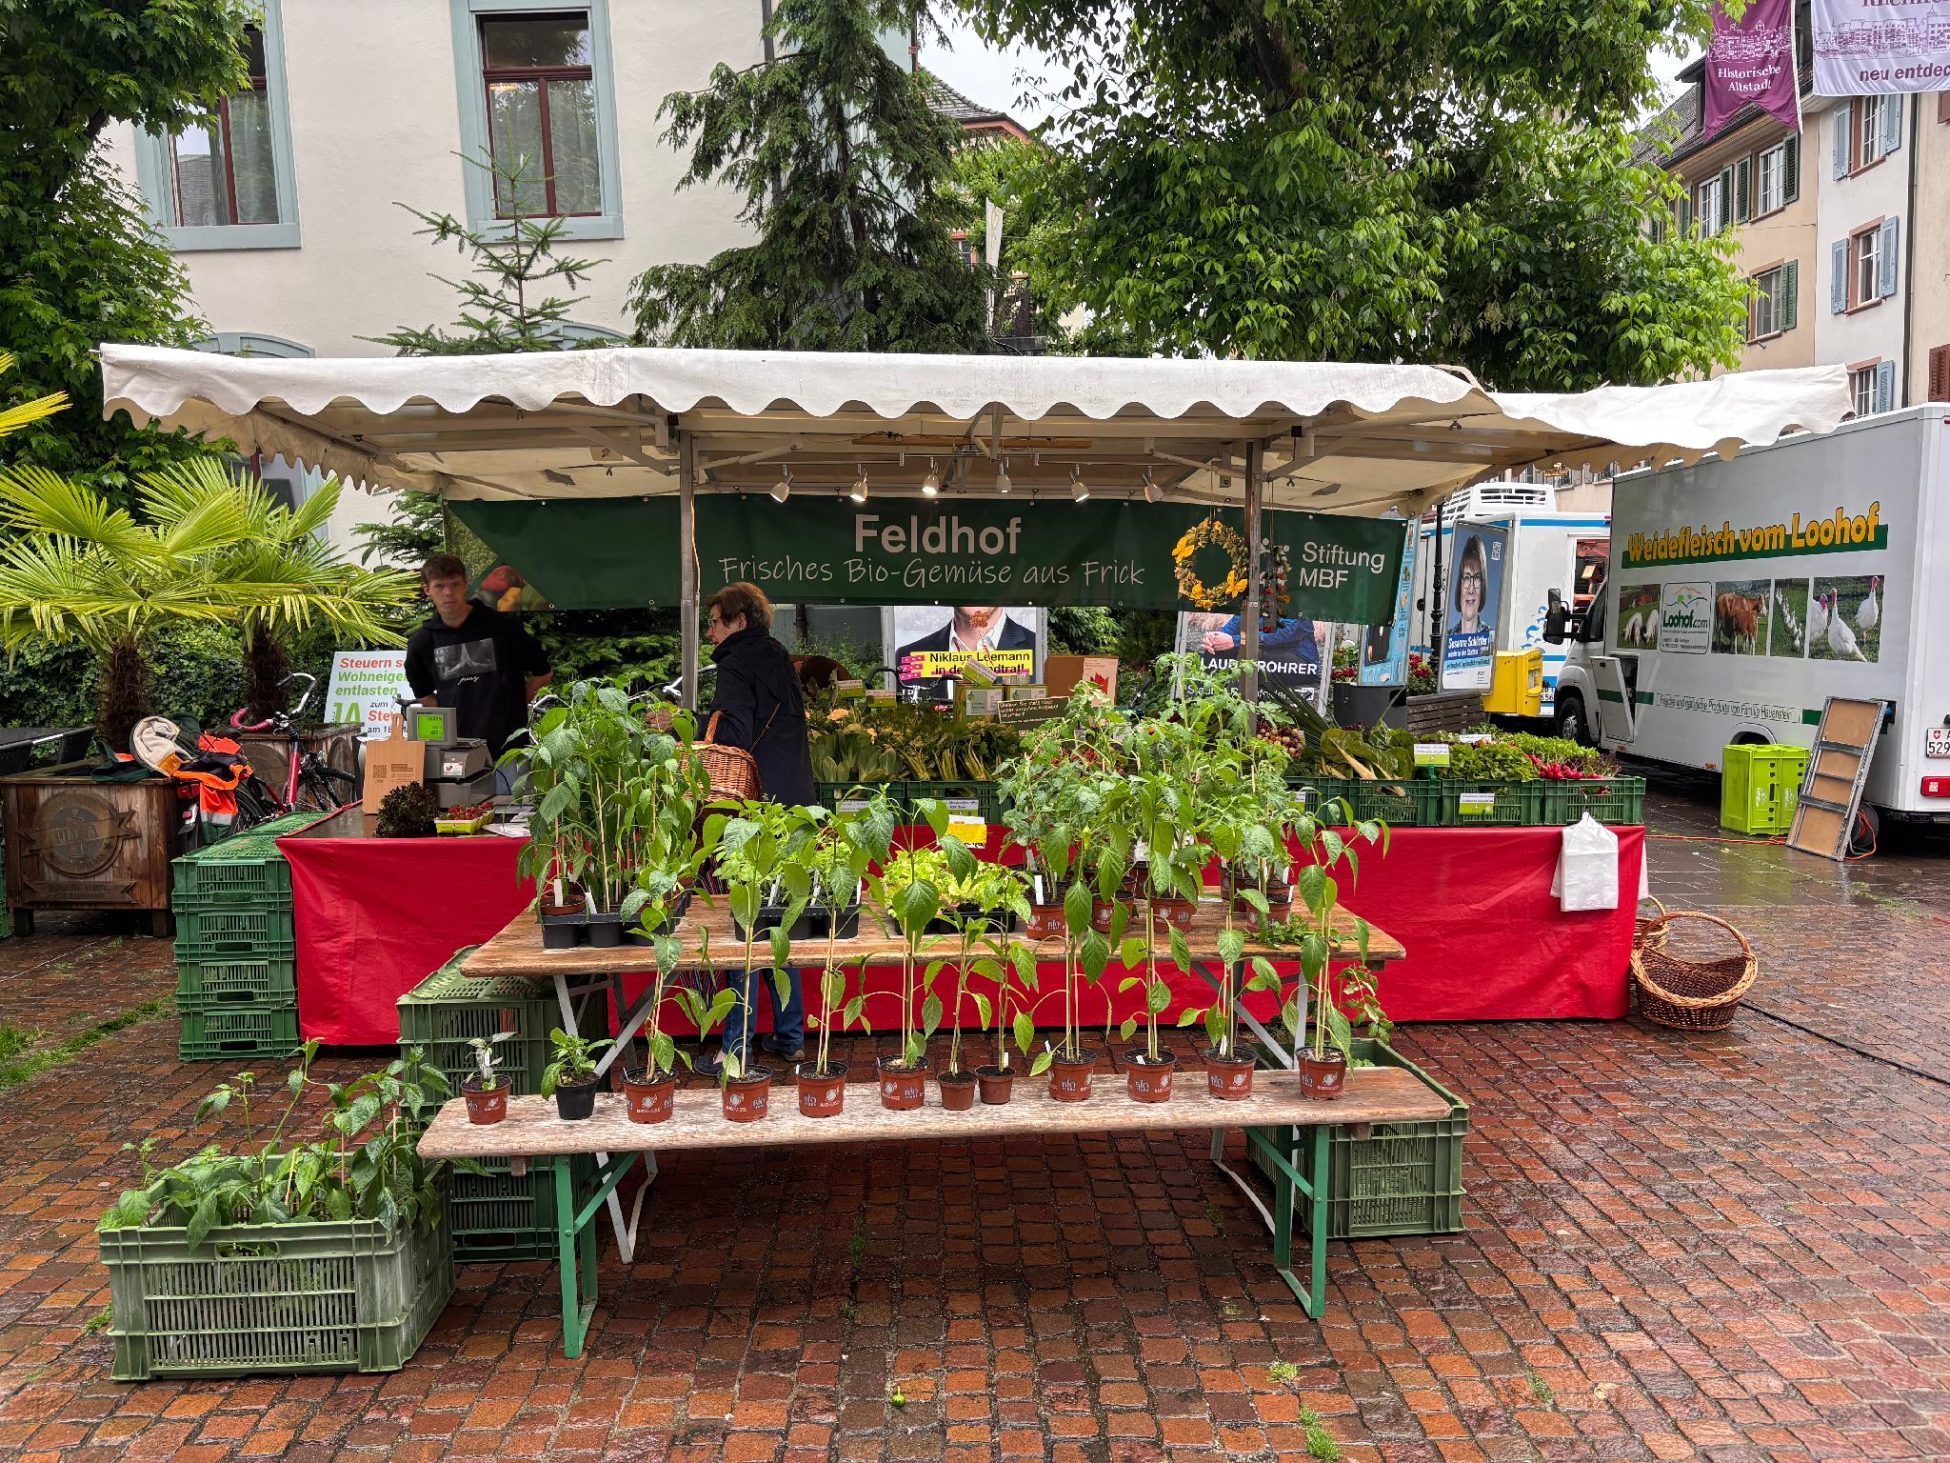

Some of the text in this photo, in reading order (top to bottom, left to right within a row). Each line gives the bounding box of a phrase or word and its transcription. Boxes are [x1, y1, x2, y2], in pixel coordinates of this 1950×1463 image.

[1718, 64, 1781, 79] Historische
[1859, 69, 1889, 81] neu
[1728, 79, 1772, 92] Altstadt
[855, 514, 1022, 555] Feldhof
[1627, 500, 1880, 562] Weidefleisch vom Loohof
[1302, 541, 1385, 574] Stiftung
[718, 554, 1145, 588] Frisches Bio-Gemüse aus Frick
[1299, 567, 1348, 589] MBF
[340, 658, 392, 669] Steuern
[930, 651, 1030, 663] Niklaus Leemann
[935, 665, 943, 675] in
[949, 664, 964, 674] de
